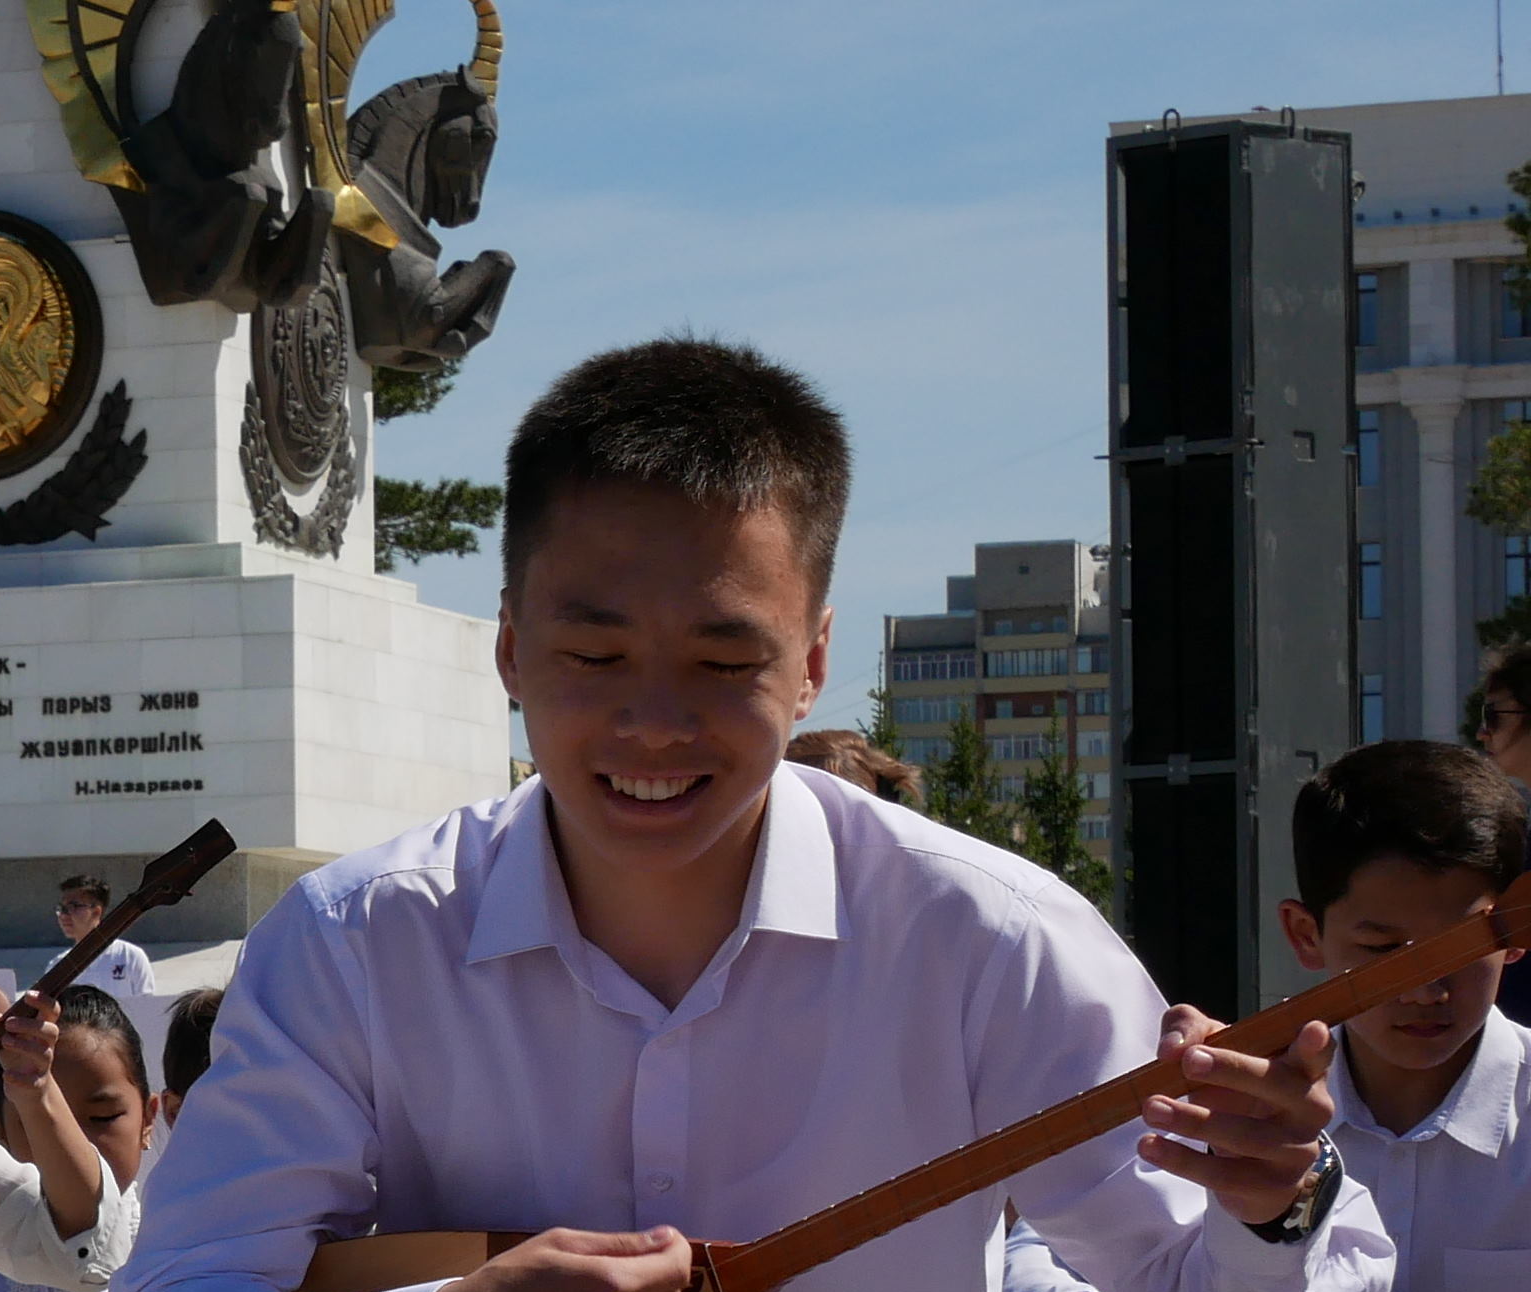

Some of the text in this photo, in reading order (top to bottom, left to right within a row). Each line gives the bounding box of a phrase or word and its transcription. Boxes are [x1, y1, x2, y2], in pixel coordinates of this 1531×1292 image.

[42, 695, 112, 716] парыз
[139, 690, 200, 712] және
[19, 730, 204, 760] жауапкершілік
